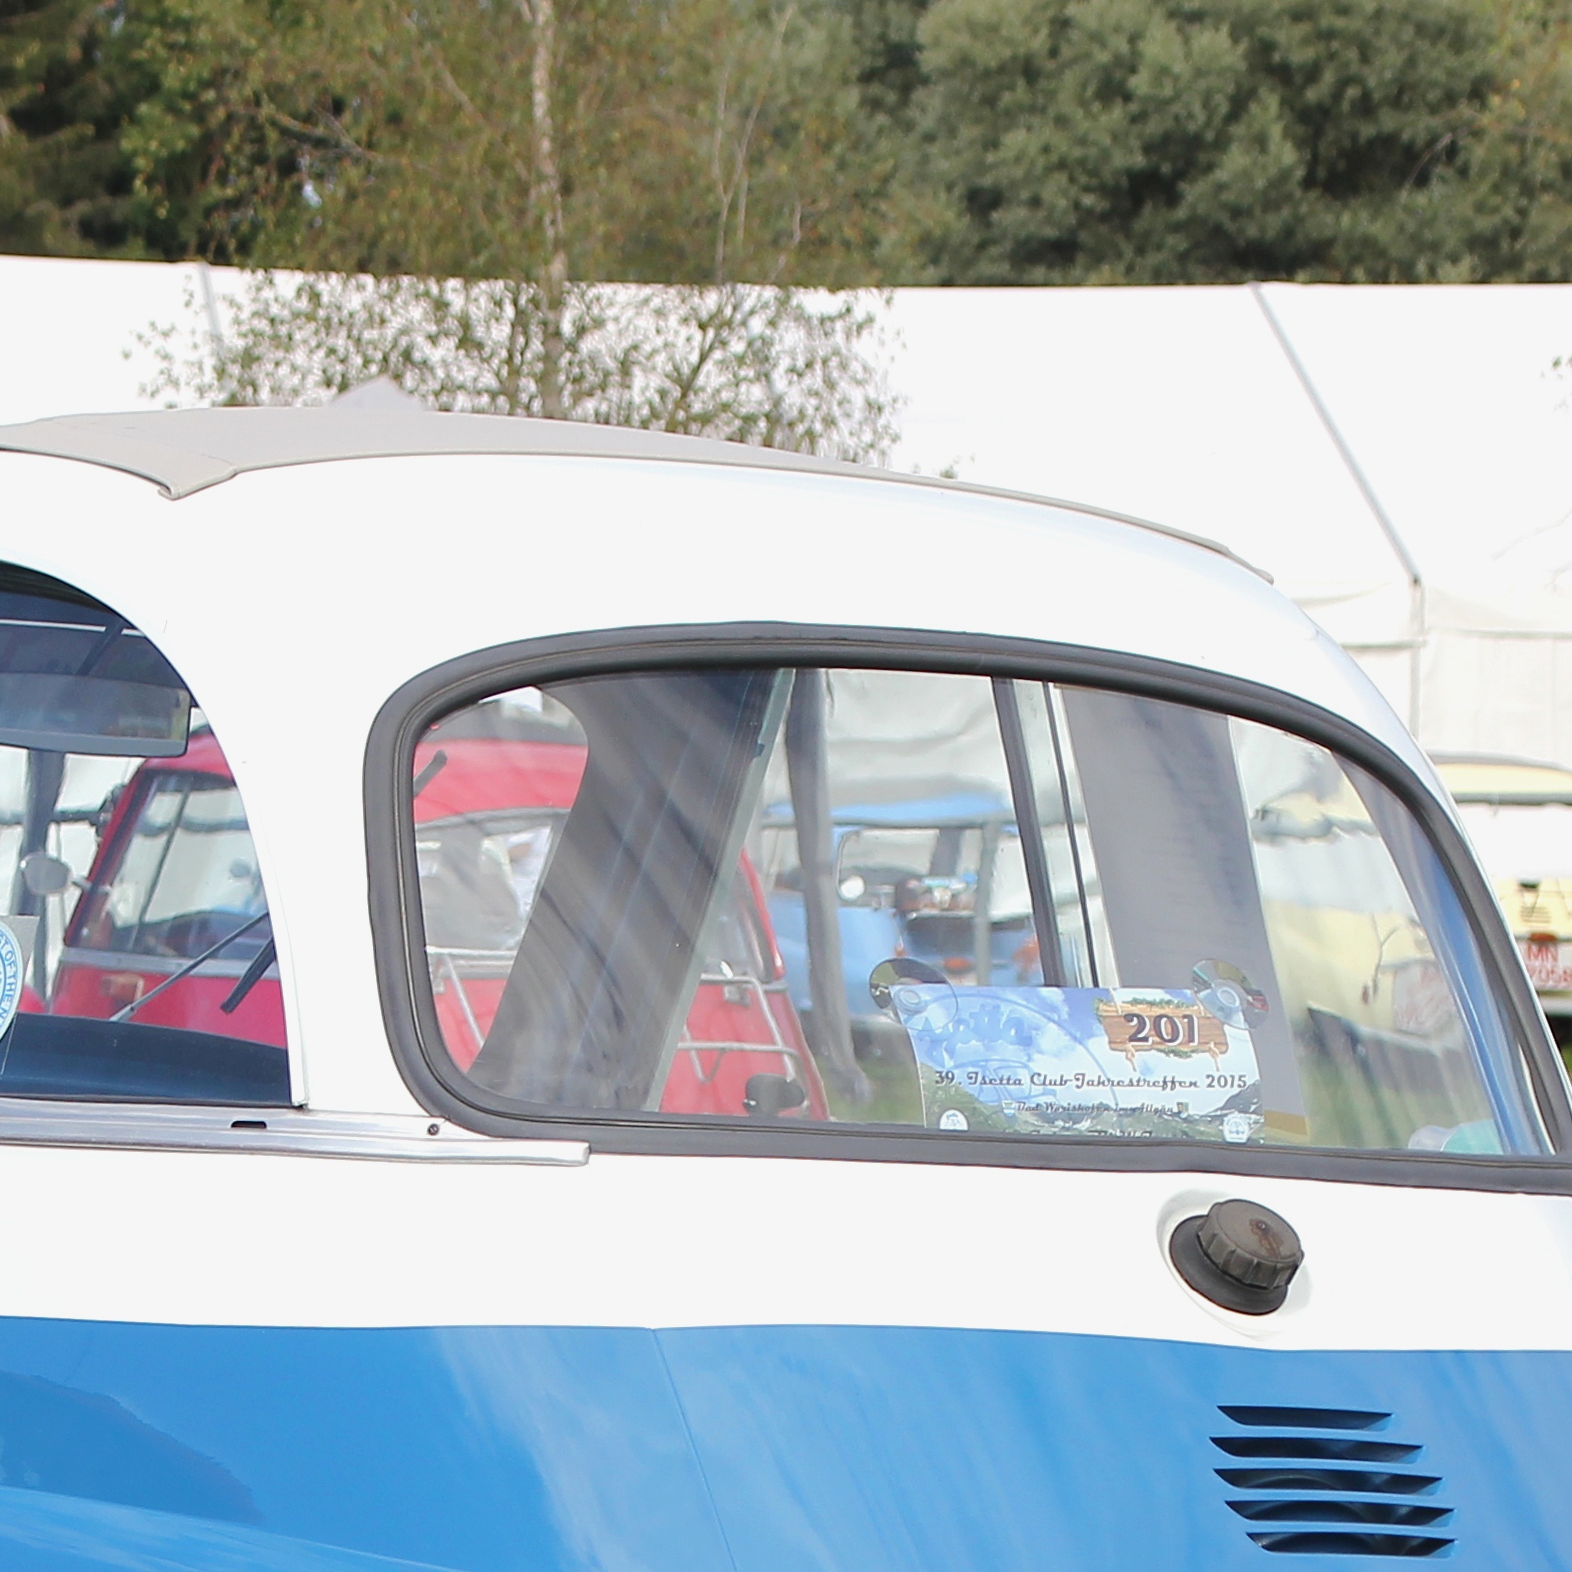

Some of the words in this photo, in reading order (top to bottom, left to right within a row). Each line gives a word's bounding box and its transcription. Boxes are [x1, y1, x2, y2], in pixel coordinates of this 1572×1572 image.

[4, 950, 16, 969] OF
[6, 970, 17, 1004] THE
[1123, 1012, 1199, 1046] 201
[934, 1071, 962, 1086] 39.
[967, 1071, 1024, 1086] Isetta
[1205, 1074, 1248, 1089] 2015
